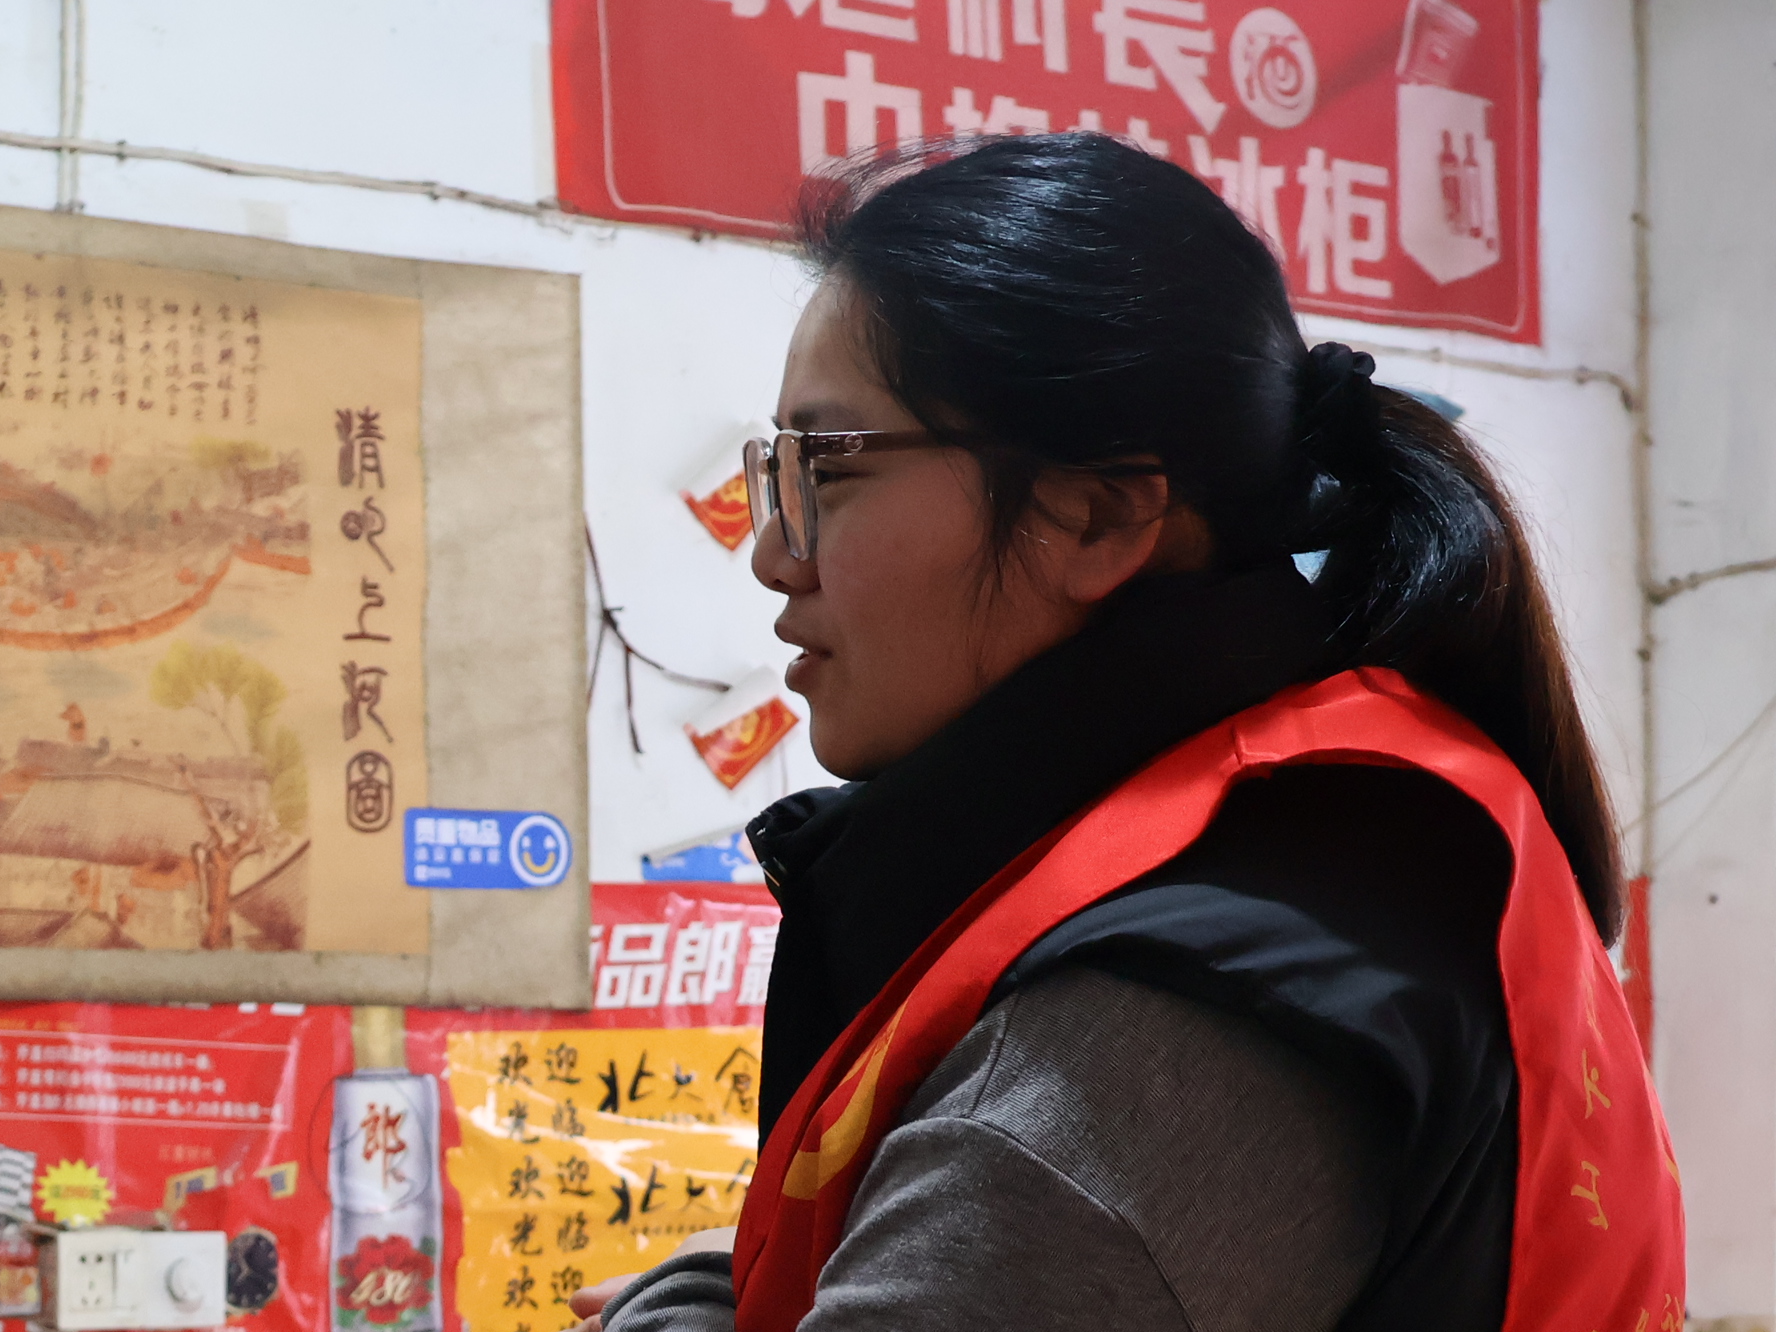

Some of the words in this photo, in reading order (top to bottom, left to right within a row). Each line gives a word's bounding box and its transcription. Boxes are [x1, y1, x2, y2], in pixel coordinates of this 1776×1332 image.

[589, 920, 781, 1010] 品郎
[498, 1042, 581, 1086] 欢迎
[510, 1155, 595, 1200] 欢迎
[510, 1210, 590, 1256] 光临
